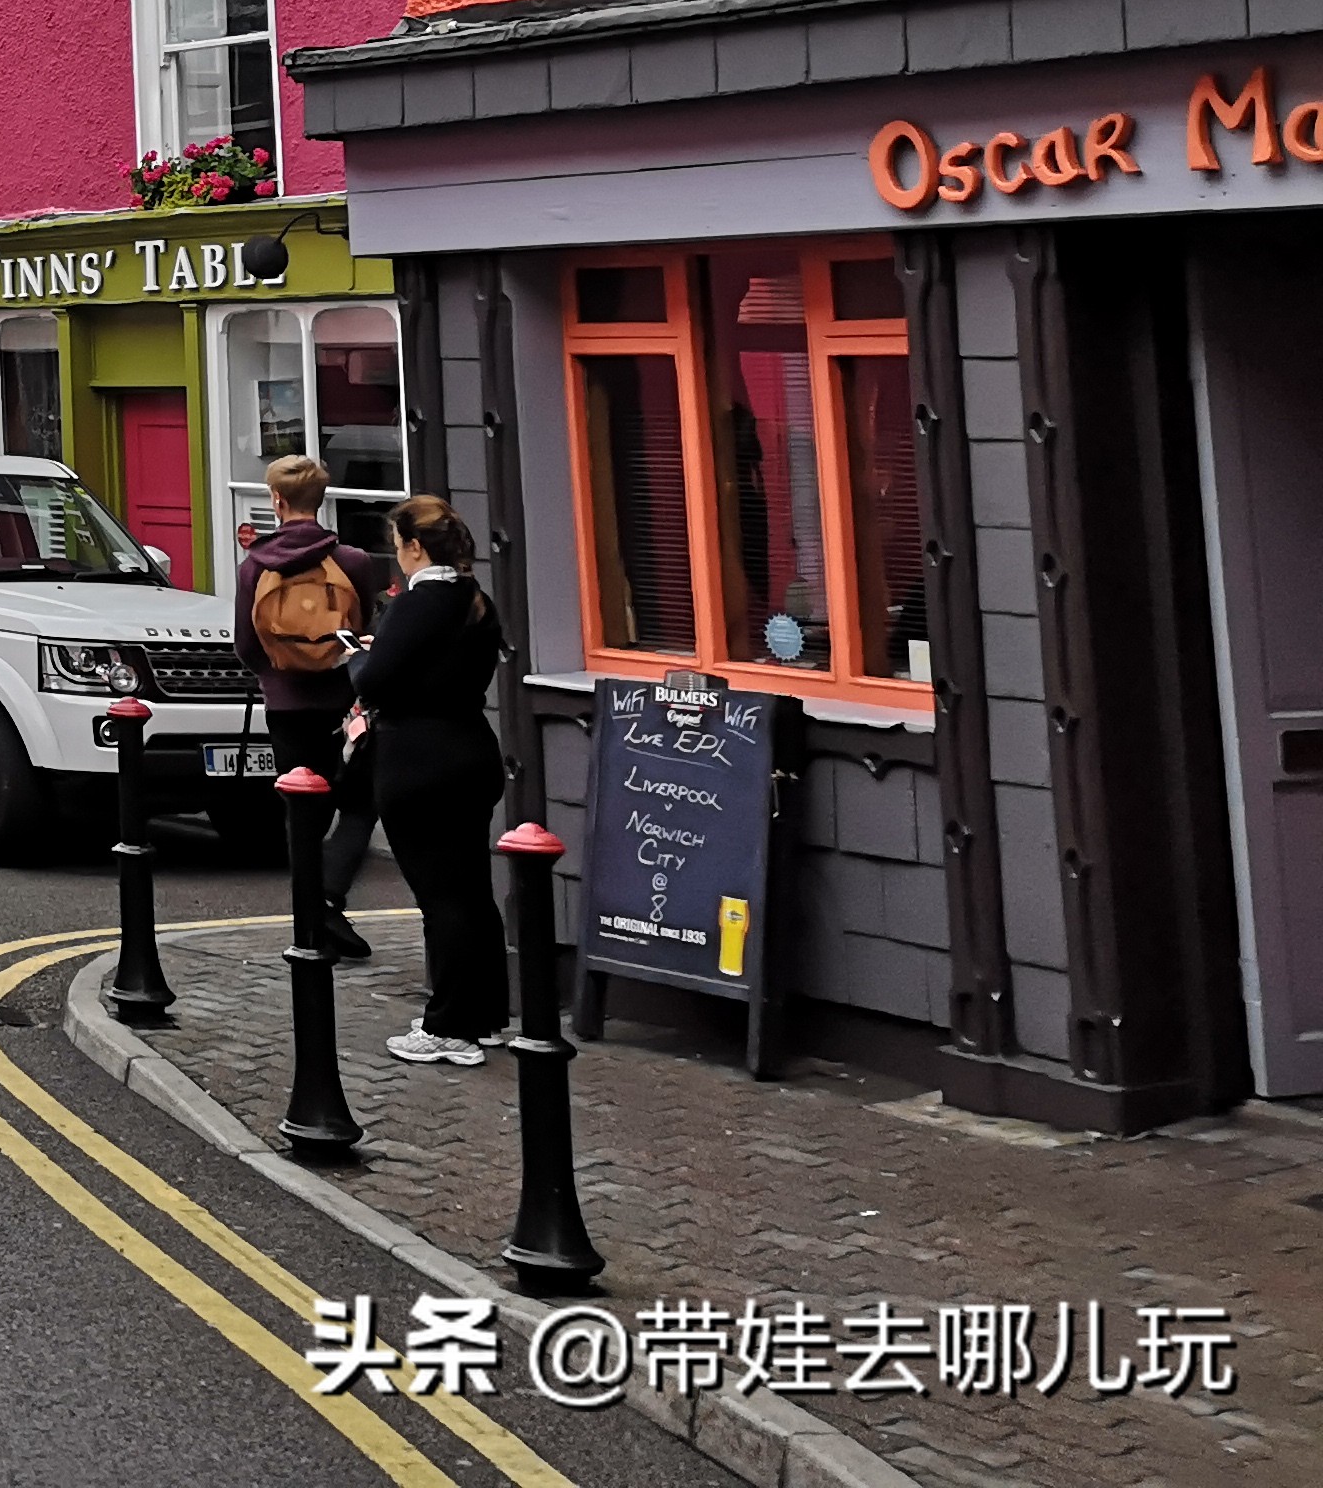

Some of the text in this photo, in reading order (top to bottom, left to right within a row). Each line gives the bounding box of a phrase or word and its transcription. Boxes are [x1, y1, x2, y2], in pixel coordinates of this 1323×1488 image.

[1186, 65, 1323, 173] Ma
[134, 239, 286, 292] TABL
[145, 627, 231, 638] DISCO
[655, 686, 719, 707] BULMERS
[673, 730, 733, 767] EPL
[624, 765, 723, 811] LIVERPOOL
[625, 810, 706, 848] NORWICH
[638, 838, 686, 871] CITY
[652, 872, 668, 891] @
[649, 894, 667, 922] 8
[613, 916, 659, 937] ORIGINAL
[681, 928, 707, 946] 1935
